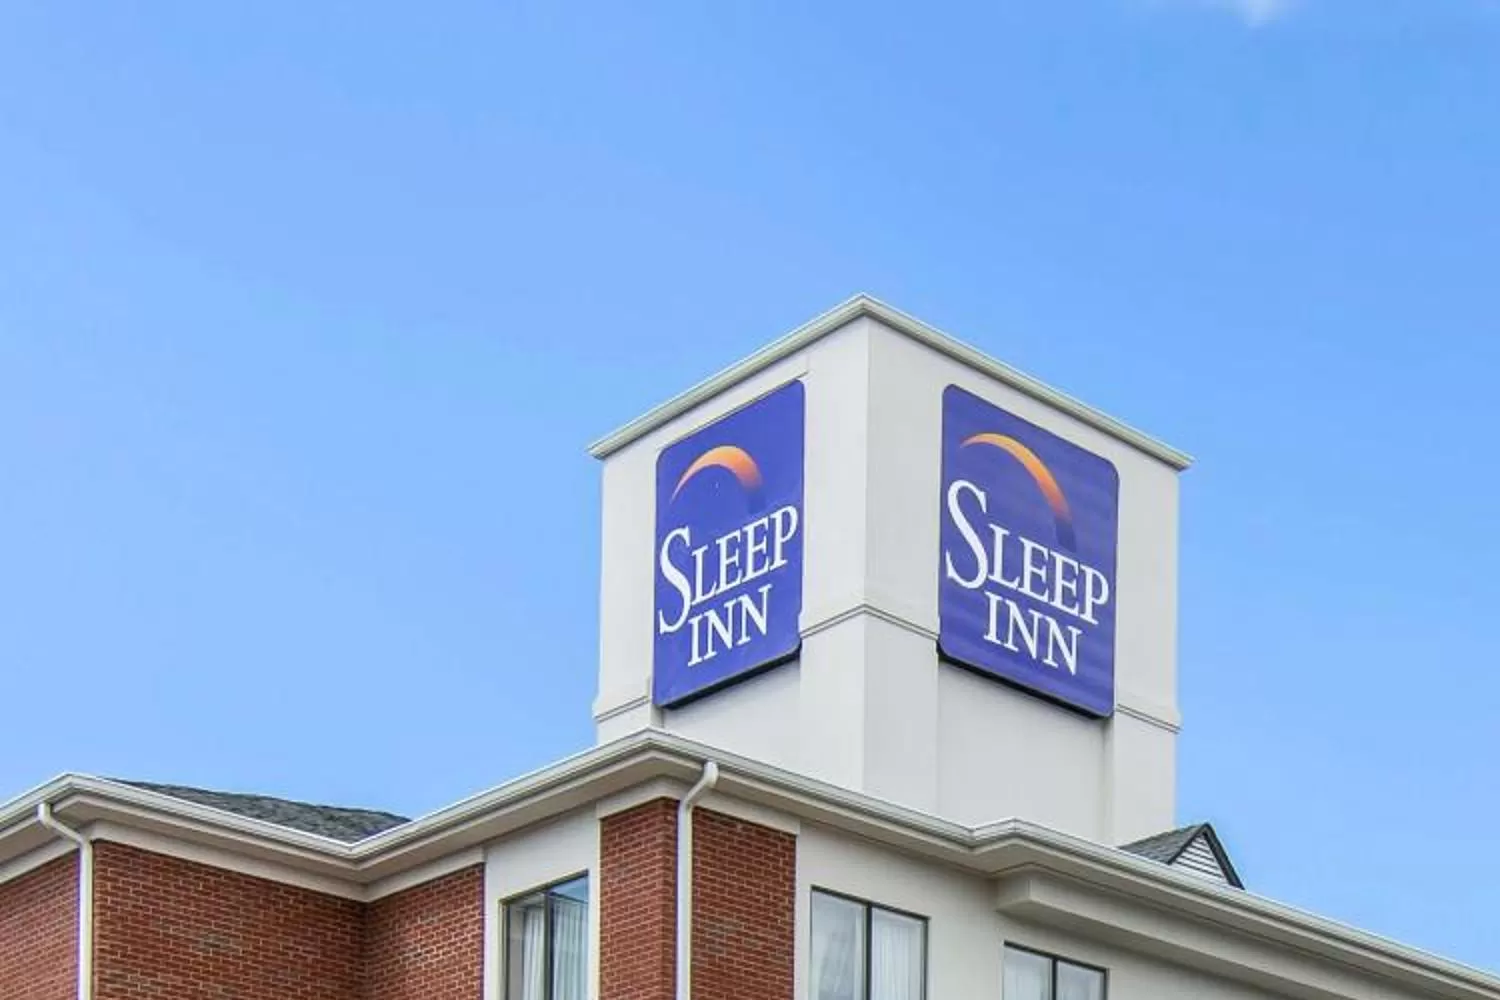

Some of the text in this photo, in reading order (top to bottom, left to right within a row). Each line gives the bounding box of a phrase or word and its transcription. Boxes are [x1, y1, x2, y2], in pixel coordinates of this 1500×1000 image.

[659, 505, 798, 634] SLEEP
[946, 480, 1109, 626] SLEEP
[688, 584, 772, 667] INN
[983, 591, 1082, 676] INN
